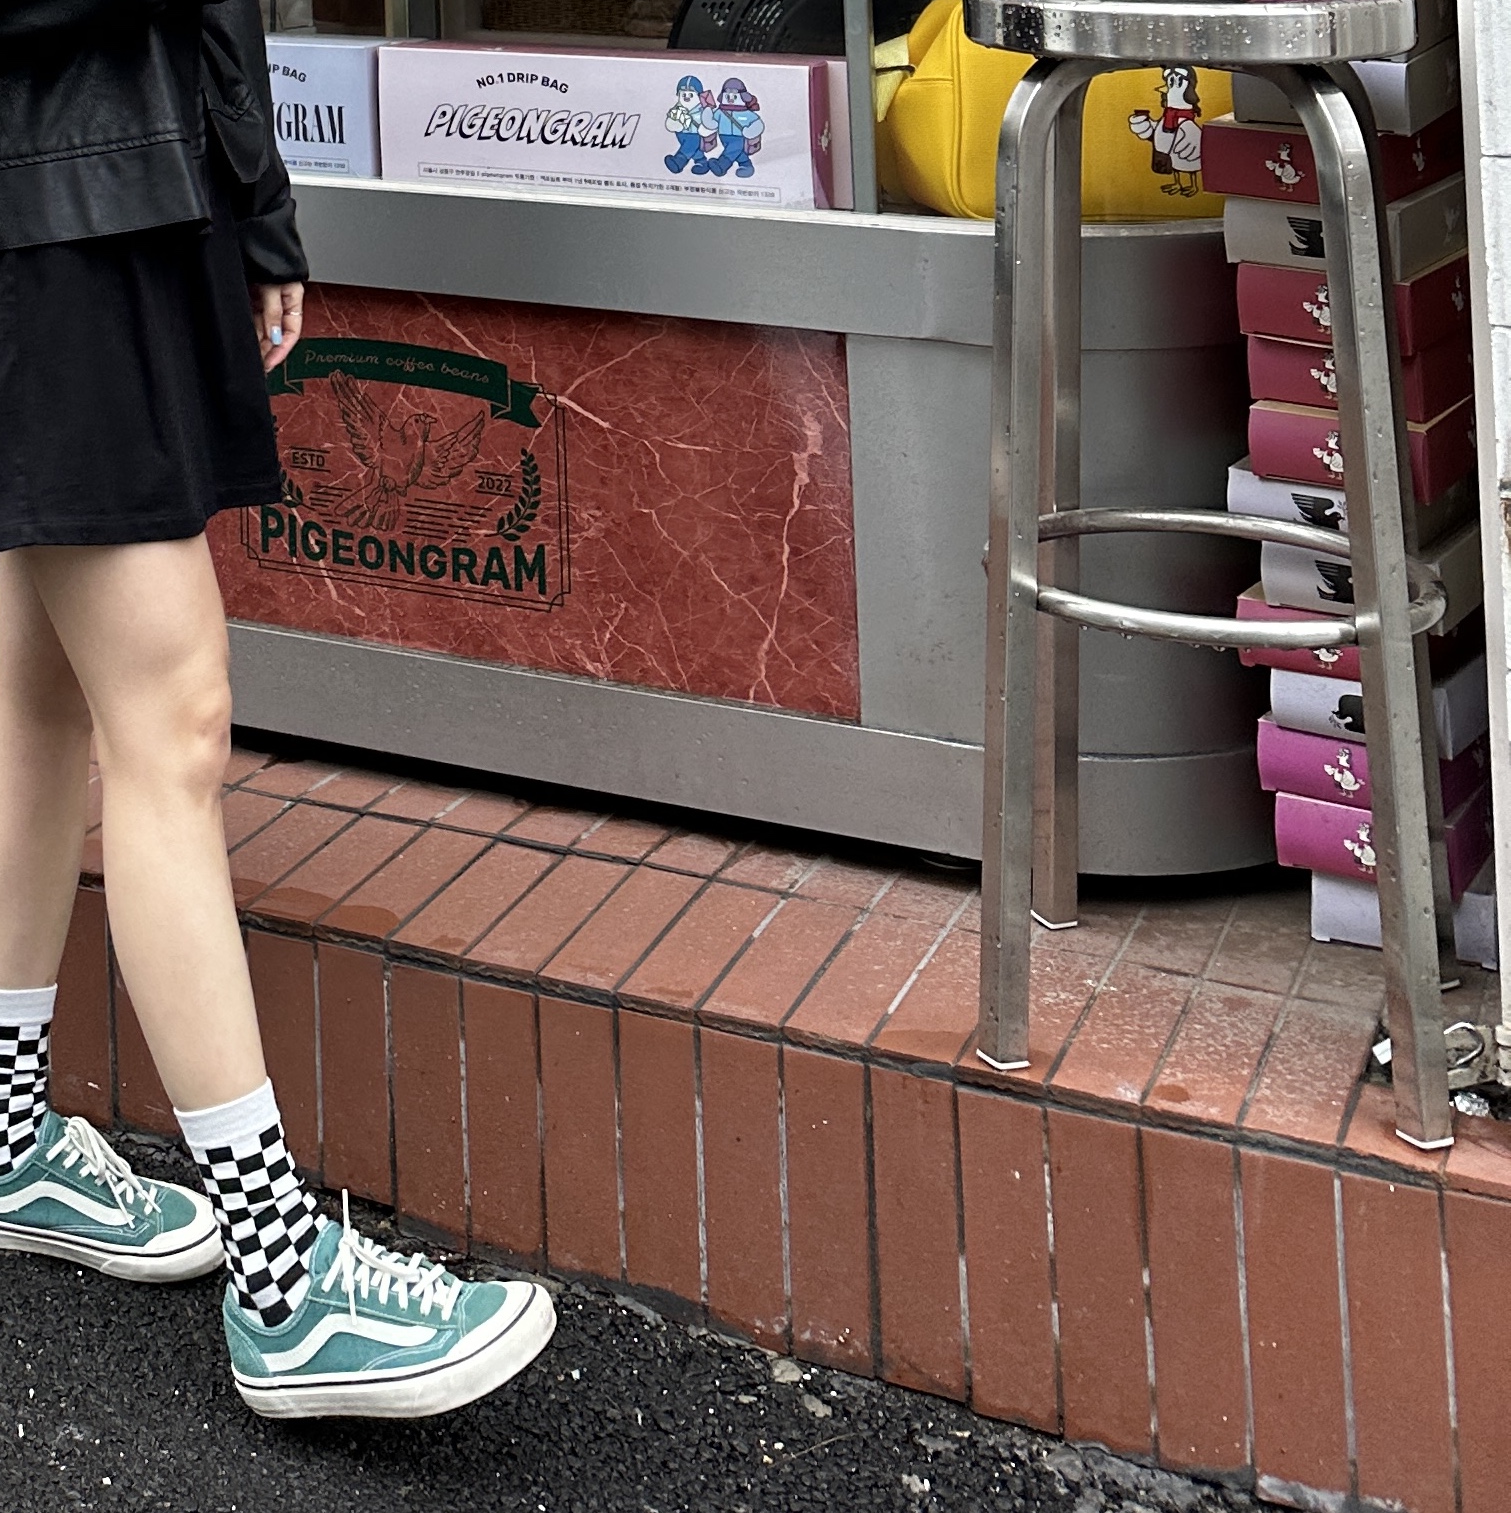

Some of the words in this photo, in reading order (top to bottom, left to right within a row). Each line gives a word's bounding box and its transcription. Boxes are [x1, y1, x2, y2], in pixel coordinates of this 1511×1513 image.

[282, 65, 307, 83] BAG
[476, 73, 504, 89] NO.1
[507, 72, 538, 84] DRIP
[541, 76, 569, 94] BAG
[273, 101, 346, 144] GRAM
[424, 103, 640, 150] PIGEONGRAM
[304, 349, 380, 365] Premium
[386, 357, 435, 372] coffee
[441, 361, 490, 383] beans
[292, 451, 326, 468] ESTD
[477, 475, 513, 492] 2022
[259, 504, 547, 596] PIGEONGRAM
